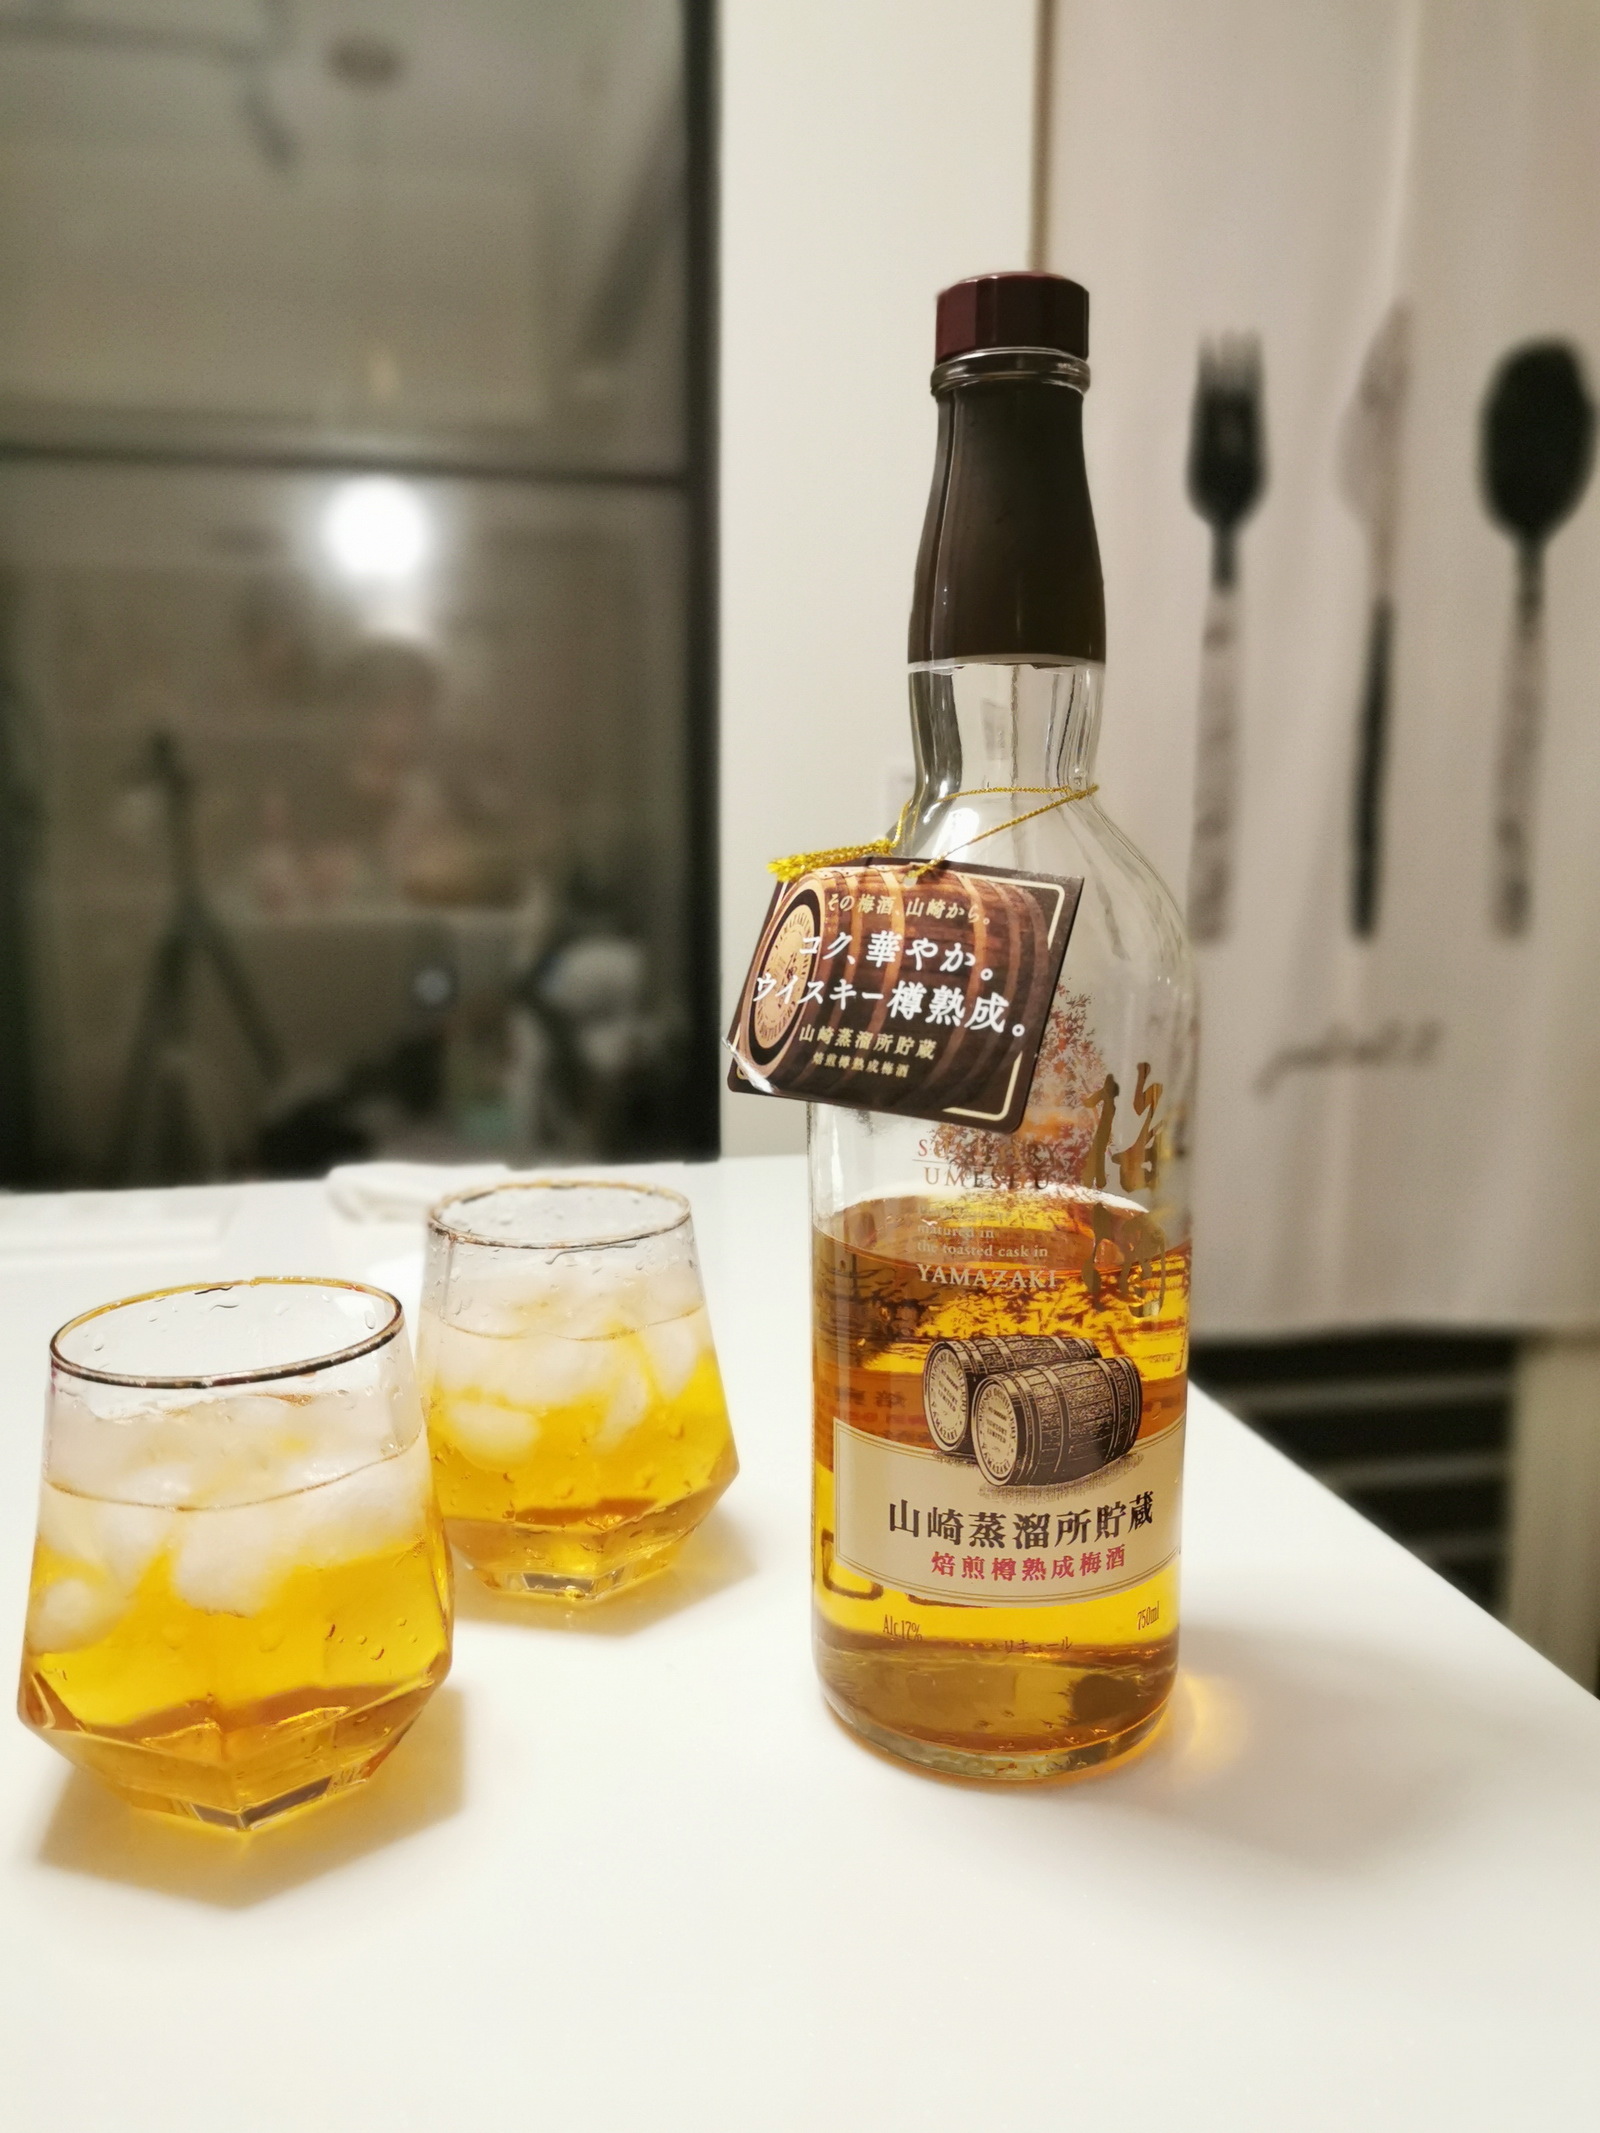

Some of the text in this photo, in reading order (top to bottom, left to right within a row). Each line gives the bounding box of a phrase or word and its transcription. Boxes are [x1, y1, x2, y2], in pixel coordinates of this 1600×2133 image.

[827, 892, 991, 925] その梅酒、山崎から。
[798, 930, 993, 981] コク、華やか。
[752, 973, 1025, 1037] ウイスキー樽熟成。
[917, 1241, 1048, 1258] the toasted cask in
[980, 1228, 994, 1239] in
[916, 1263, 1057, 1289] YAMAZAKI
[889, 1490, 1154, 1549] 山崎蒸溜所貯蔵
[931, 1543, 1126, 1582] 焙煎樽熟成梅酒
[1137, 1600, 1160, 1631] 750ml
